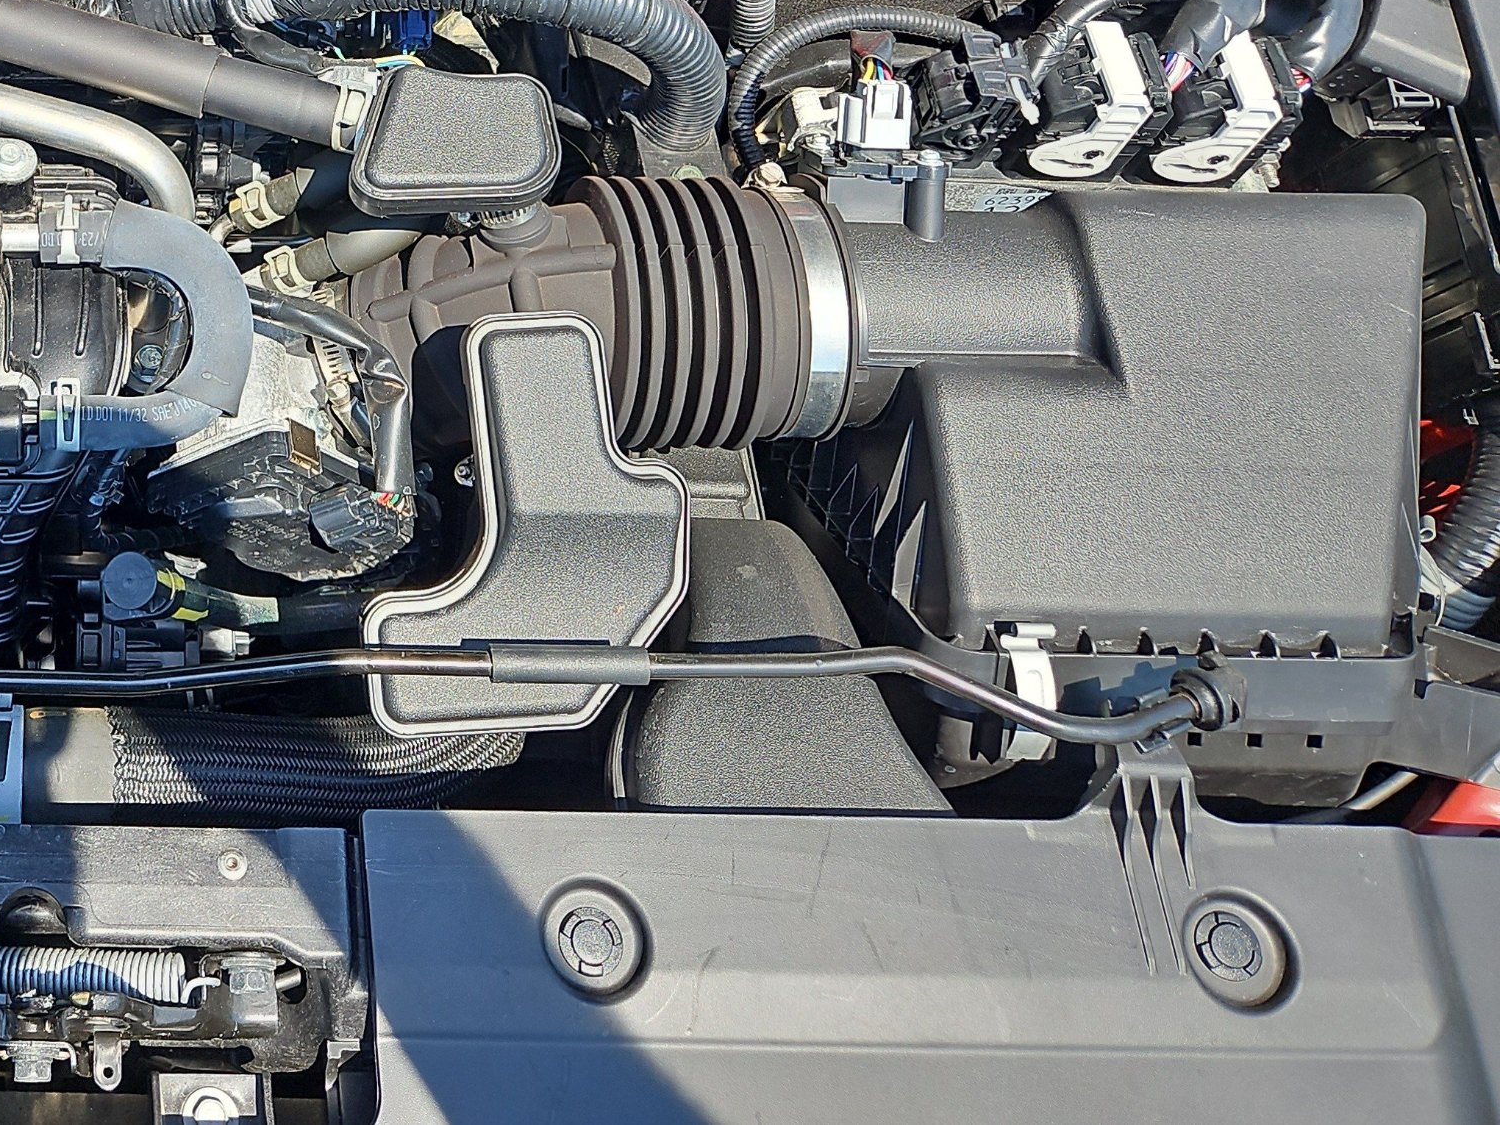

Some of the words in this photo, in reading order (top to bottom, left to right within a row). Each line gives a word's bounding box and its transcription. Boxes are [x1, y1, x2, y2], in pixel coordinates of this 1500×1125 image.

[96, 406, 114, 421] DOT
[117, 407, 148, 423] 11/32
[151, 404, 172, 421] SAE
